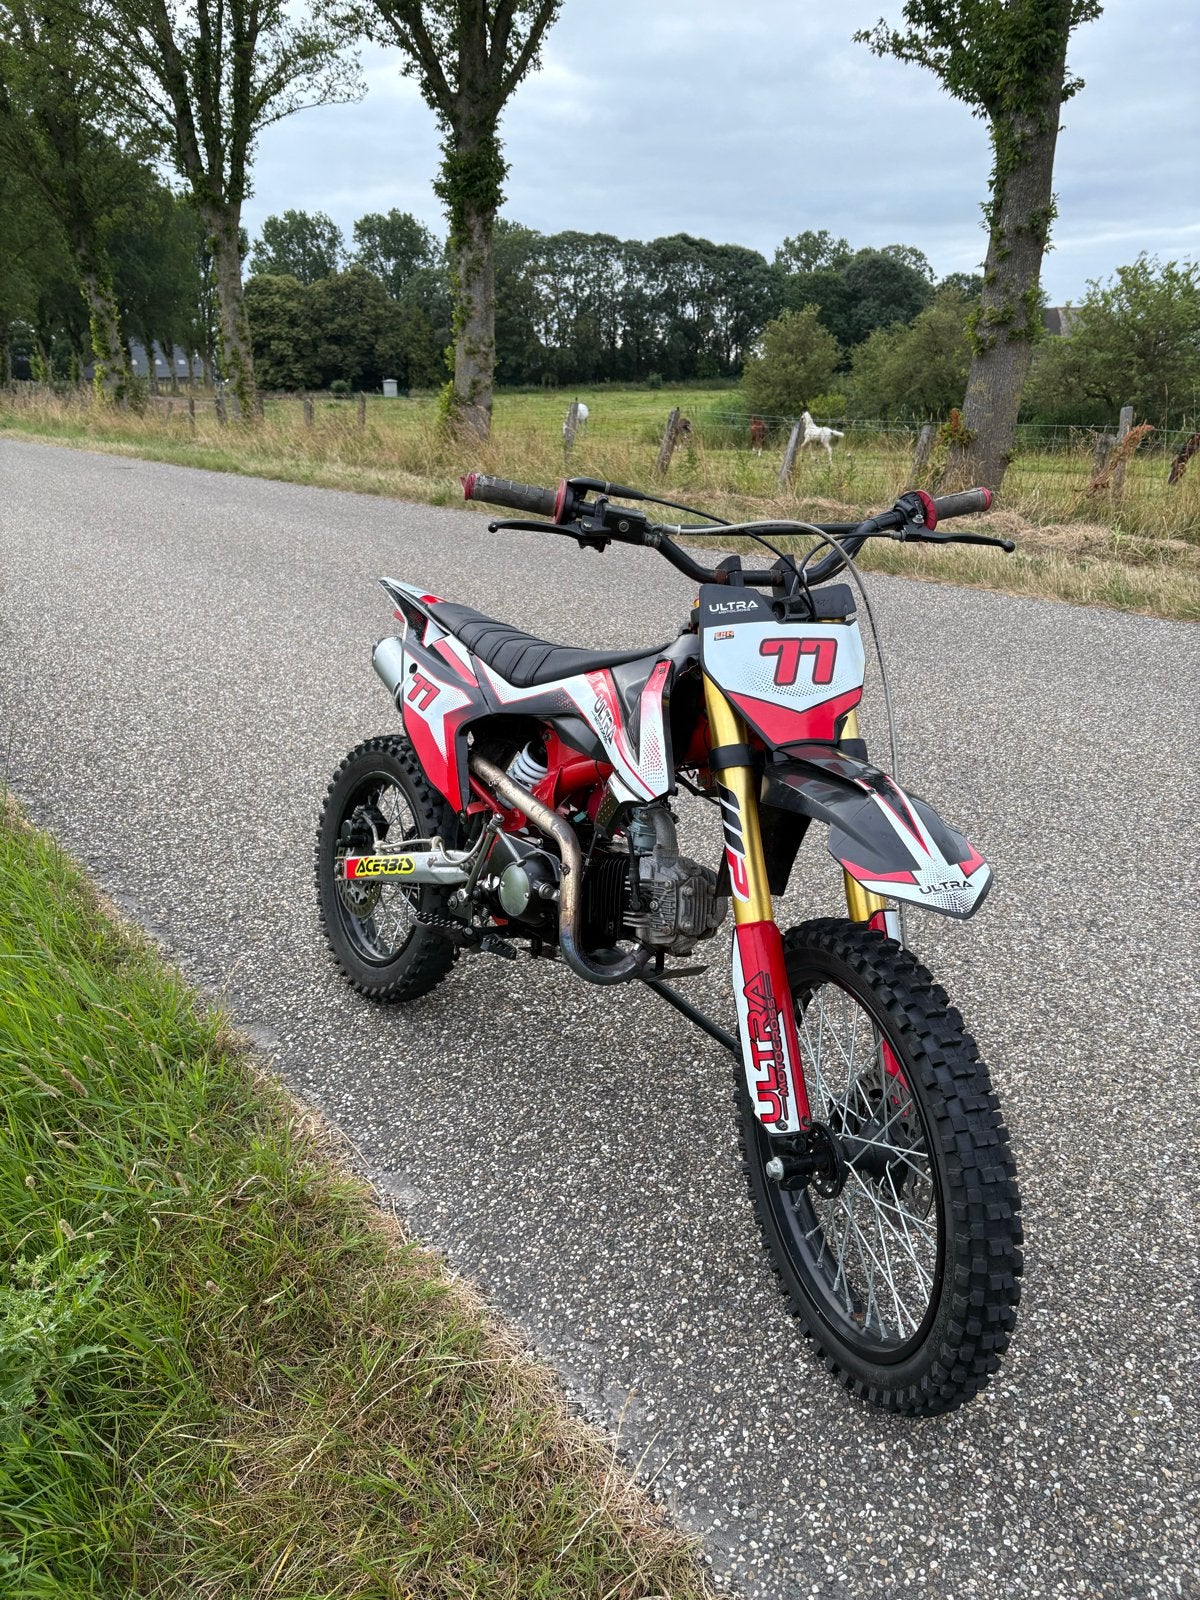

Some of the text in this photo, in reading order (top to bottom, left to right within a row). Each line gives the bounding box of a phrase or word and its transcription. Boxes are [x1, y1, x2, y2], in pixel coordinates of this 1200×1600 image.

[709, 600, 759, 612] ULTRA
[759, 637, 838, 686] 77
[407, 672, 441, 711] 77
[594, 696, 616, 745] ULTRA
[356, 858, 413, 873] ACERBIS
[919, 881, 974, 894] ULTRA
[743, 971, 783, 1124] ULTRA
[766, 997, 789, 1097] MOTOCROSS
